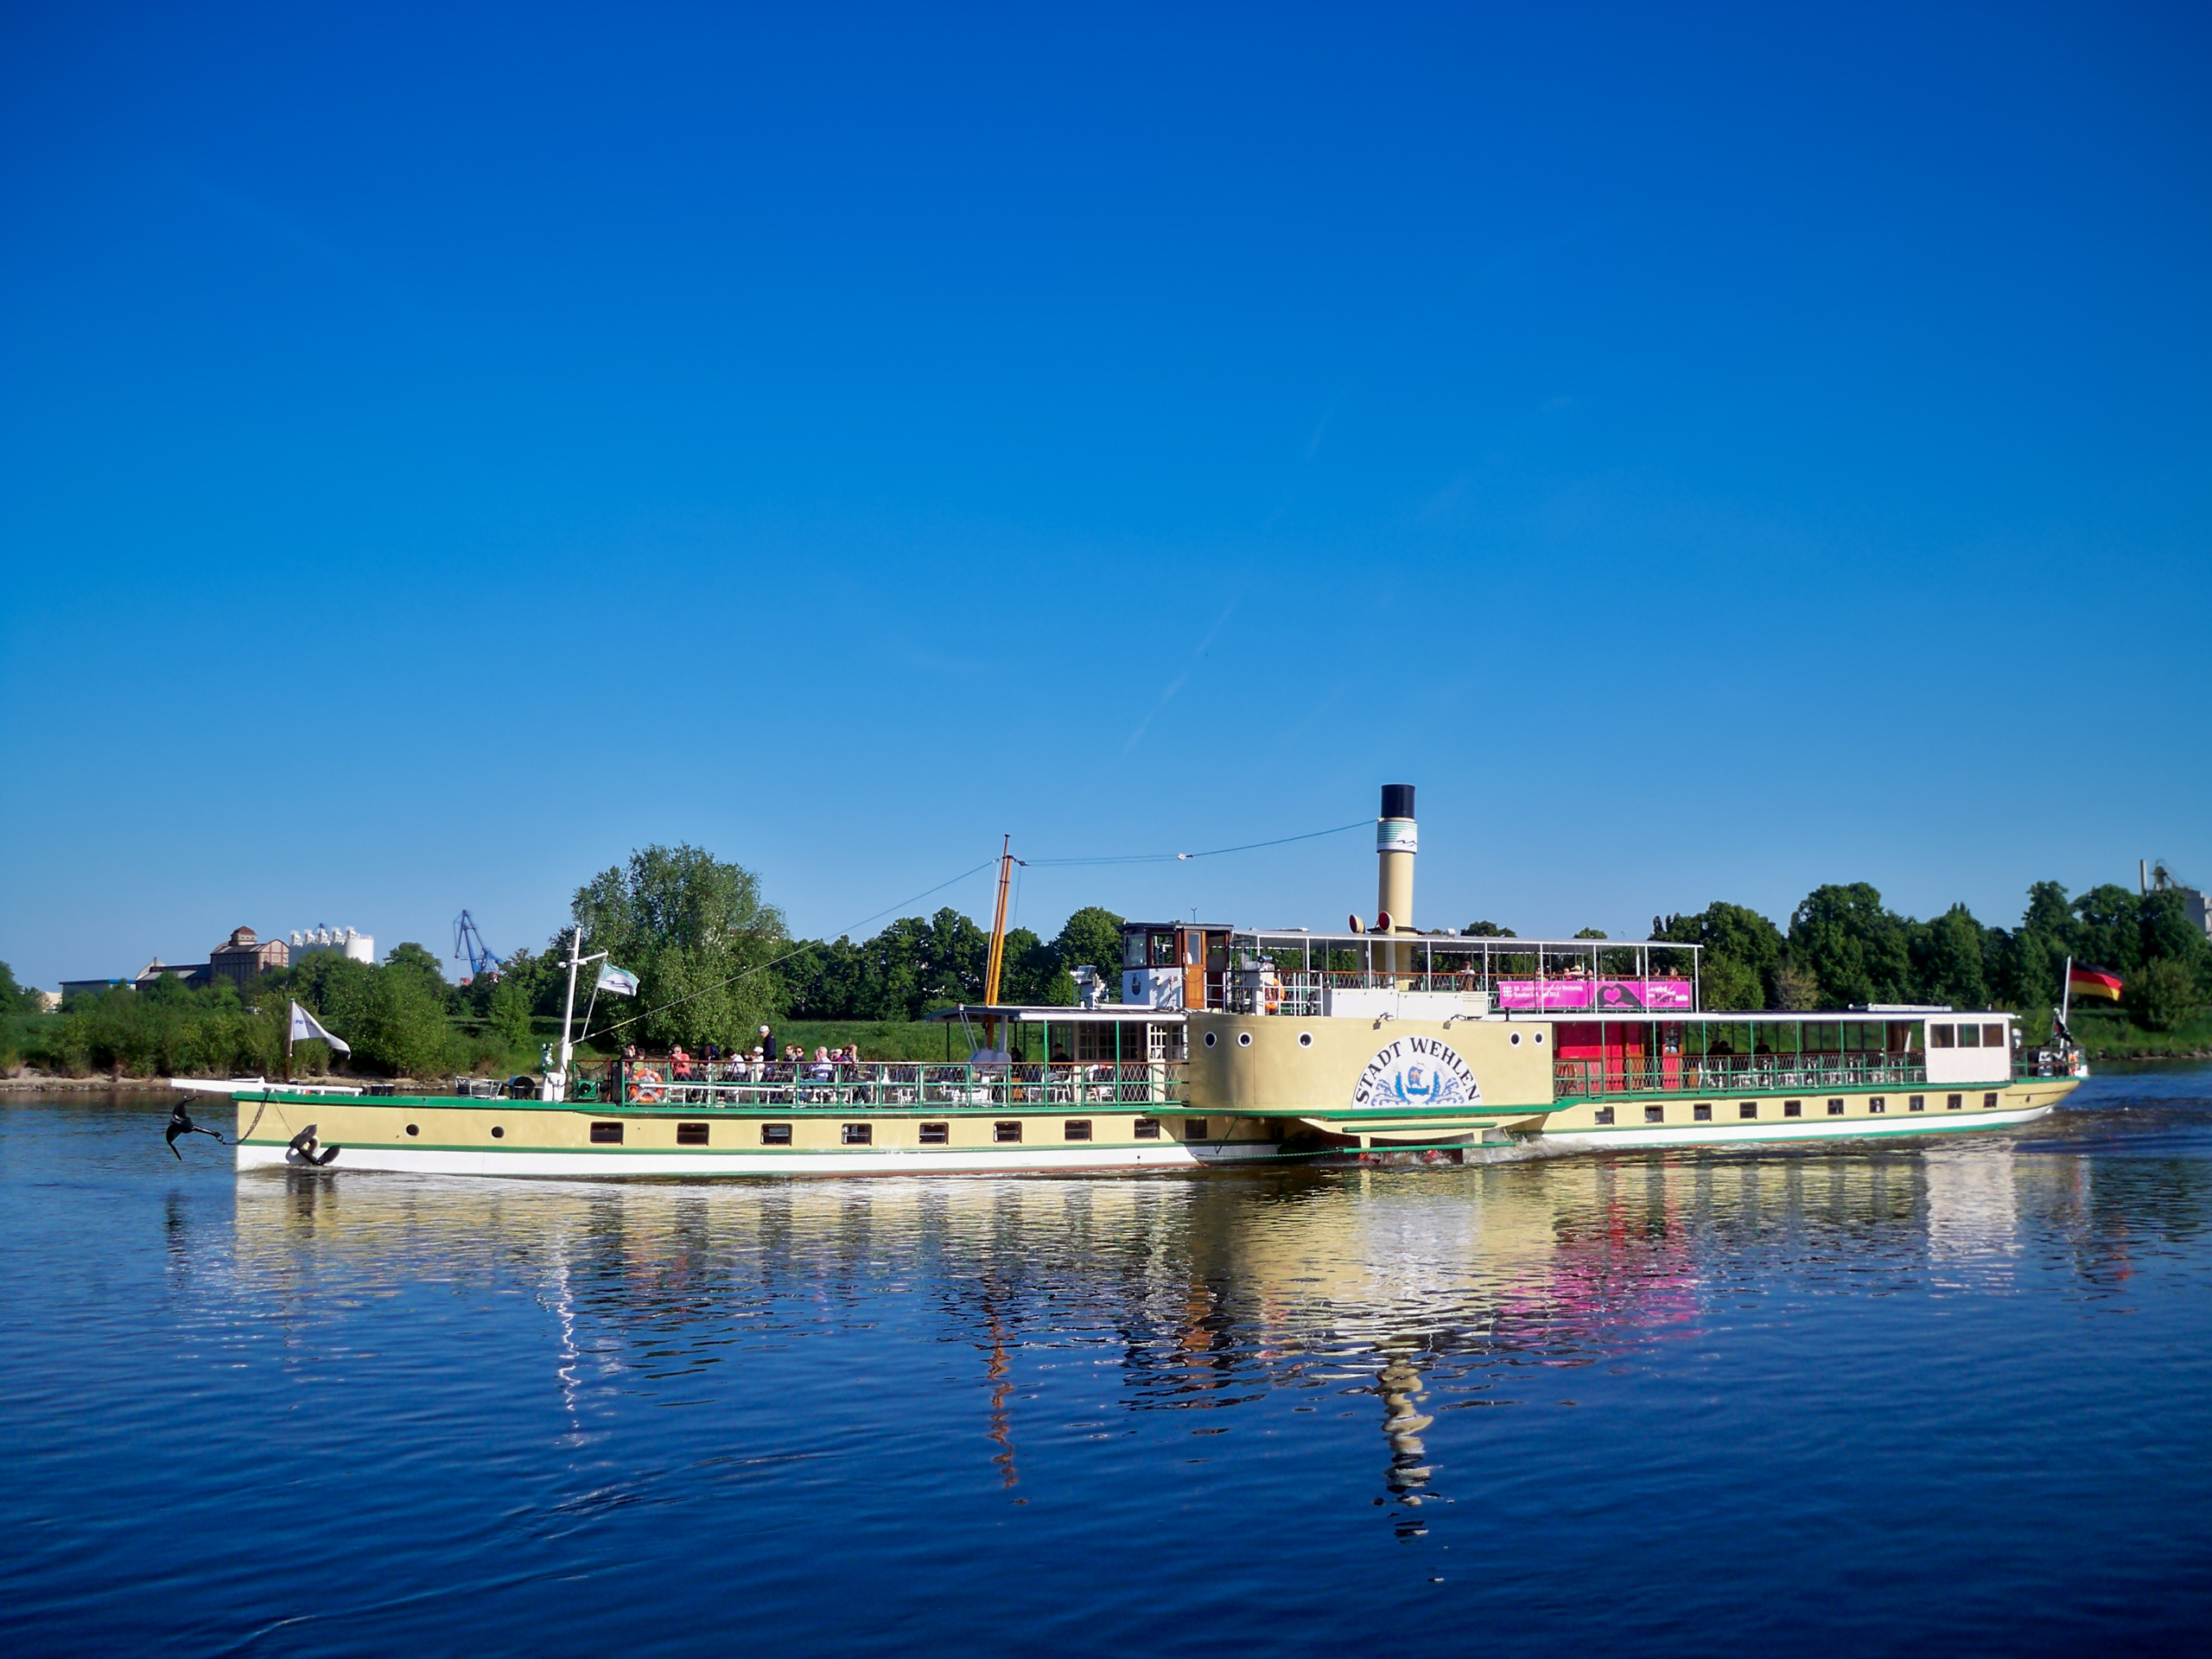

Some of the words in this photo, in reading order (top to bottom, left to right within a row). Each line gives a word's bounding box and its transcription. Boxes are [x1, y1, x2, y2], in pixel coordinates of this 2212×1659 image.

[1655, 994, 1676, 1002] Herz
[1356, 1041, 1402, 1103] STADT
[1409, 1037, 1480, 1101] WEHLEN
